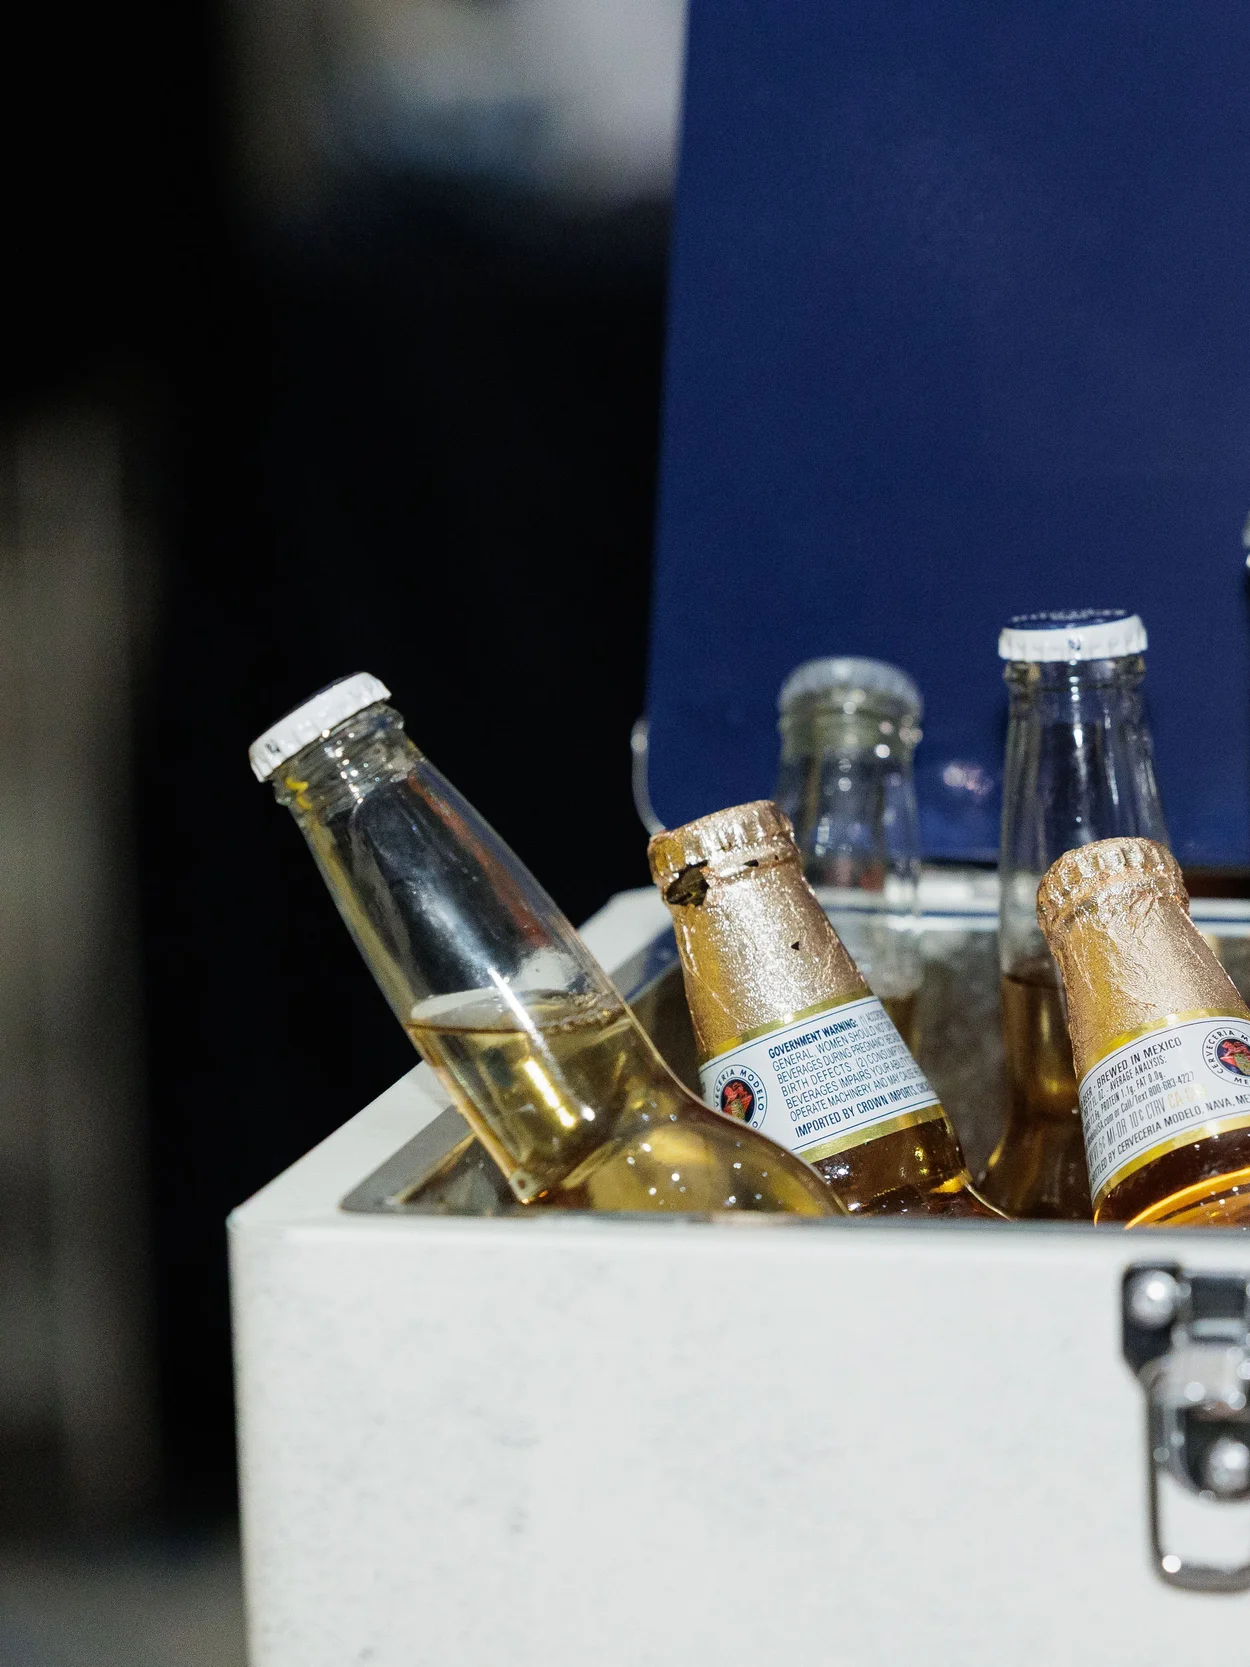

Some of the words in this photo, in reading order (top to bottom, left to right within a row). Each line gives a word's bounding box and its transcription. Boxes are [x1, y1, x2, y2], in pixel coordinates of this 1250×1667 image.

[768, 1029, 824, 1059] GOVERNMENT
[823, 1018, 859, 1037] WARNING:
[816, 1036, 849, 1055] WOMEN
[848, 1025, 876, 1043] SHOULD
[1205, 1029, 1235, 1074] CERVECERIA
[777, 1057, 824, 1084] BEVERAGES
[823, 1048, 853, 1067] DURING
[850, 1036, 885, 1057] PREGNANCY
[781, 1078, 810, 1098] BIRTH
[811, 1061, 855, 1085] DEFECTS.
[856, 1056, 868, 1071] (2)
[1096, 1059, 1129, 1089] BREWED
[1130, 1052, 1141, 1066] IN
[1143, 1036, 1183, 1061] MEXICO
[1109, 1069, 1134, 1092] AVERAGE
[1135, 1055, 1168, 1077] ANALYSIS:
[739, 1068, 765, 1111] MODELO
[785, 1083, 839, 1110] BEVERAGES
[840, 1069, 872, 1089] IMPAIRS
[870, 1062, 892, 1077] YOUR
[789, 1099, 829, 1122] OPERATE
[829, 1082, 875, 1108] MACHINERY,
[873, 1077, 889, 1091] AND
[887, 1072, 901, 1085] MAY
[1100, 1092, 1120, 1113] PROTEIN
[1135, 1074, 1147, 1090] FAT
[1120, 1091, 1149, 1113] Call/Text
[1148, 1071, 1195, 1098] 800-683-4227
[1144, 1095, 1166, 1121] CTRV
[1167, 1091, 1184, 1109] CA
[795, 1111, 843, 1138] IMPORTED
[843, 1106, 857, 1120] BY
[856, 1094, 889, 1114] CROWN
[1108, 1149, 1117, 1163] BY
[1117, 1121, 1162, 1155] CERVECERIA
